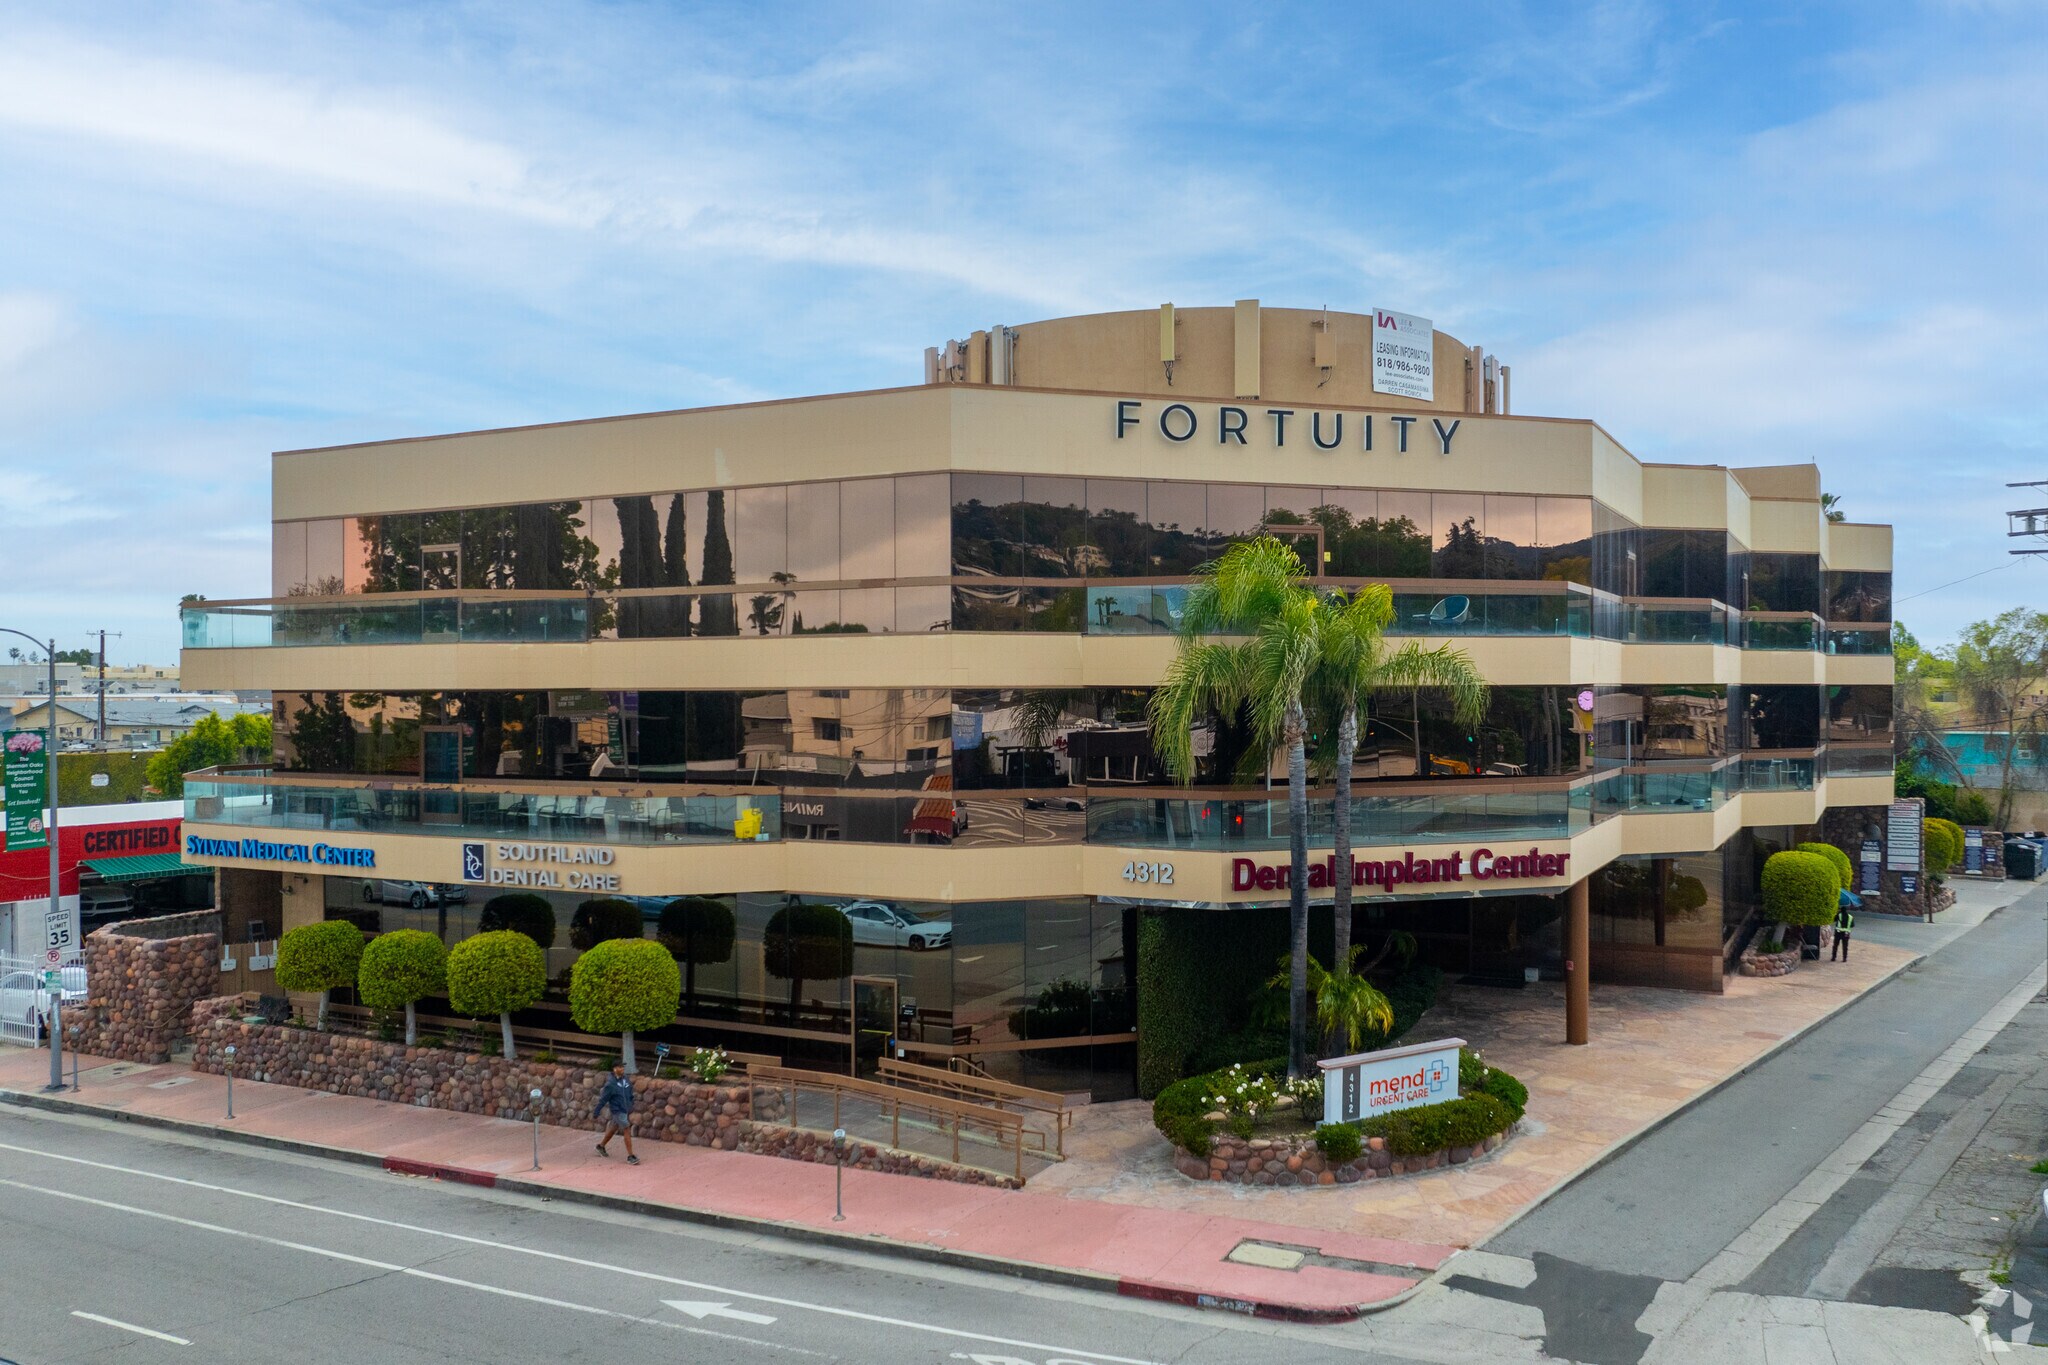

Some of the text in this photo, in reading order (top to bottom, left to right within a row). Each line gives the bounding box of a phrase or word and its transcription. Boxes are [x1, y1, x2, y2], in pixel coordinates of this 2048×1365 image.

[1376, 342, 1430, 363] LEASING INFORMATION
[1377, 357, 1430, 376] 818/986-9800
[1388, 386, 1404, 395] SCOTT
[1117, 401, 1461, 455] FORTUITY
[84, 826, 170, 853] CERTIFIED
[187, 835, 375, 867] SYLVAN MEDICAL CENTER
[498, 843, 615, 866] SOUTHLAND
[490, 868, 621, 891] DENTAL CARE
[1121, 861, 1174, 884] 4312
[1232, 855, 1336, 892] Denal
[1470, 847, 1570, 881] Center
[48, 913, 69, 923] SPEED
[50, 922, 67, 931] LIMIT
[50, 930, 69, 946] 35
[1370, 1067, 1424, 1095] mend
[1370, 1087, 1429, 1108] URGENT CARE
